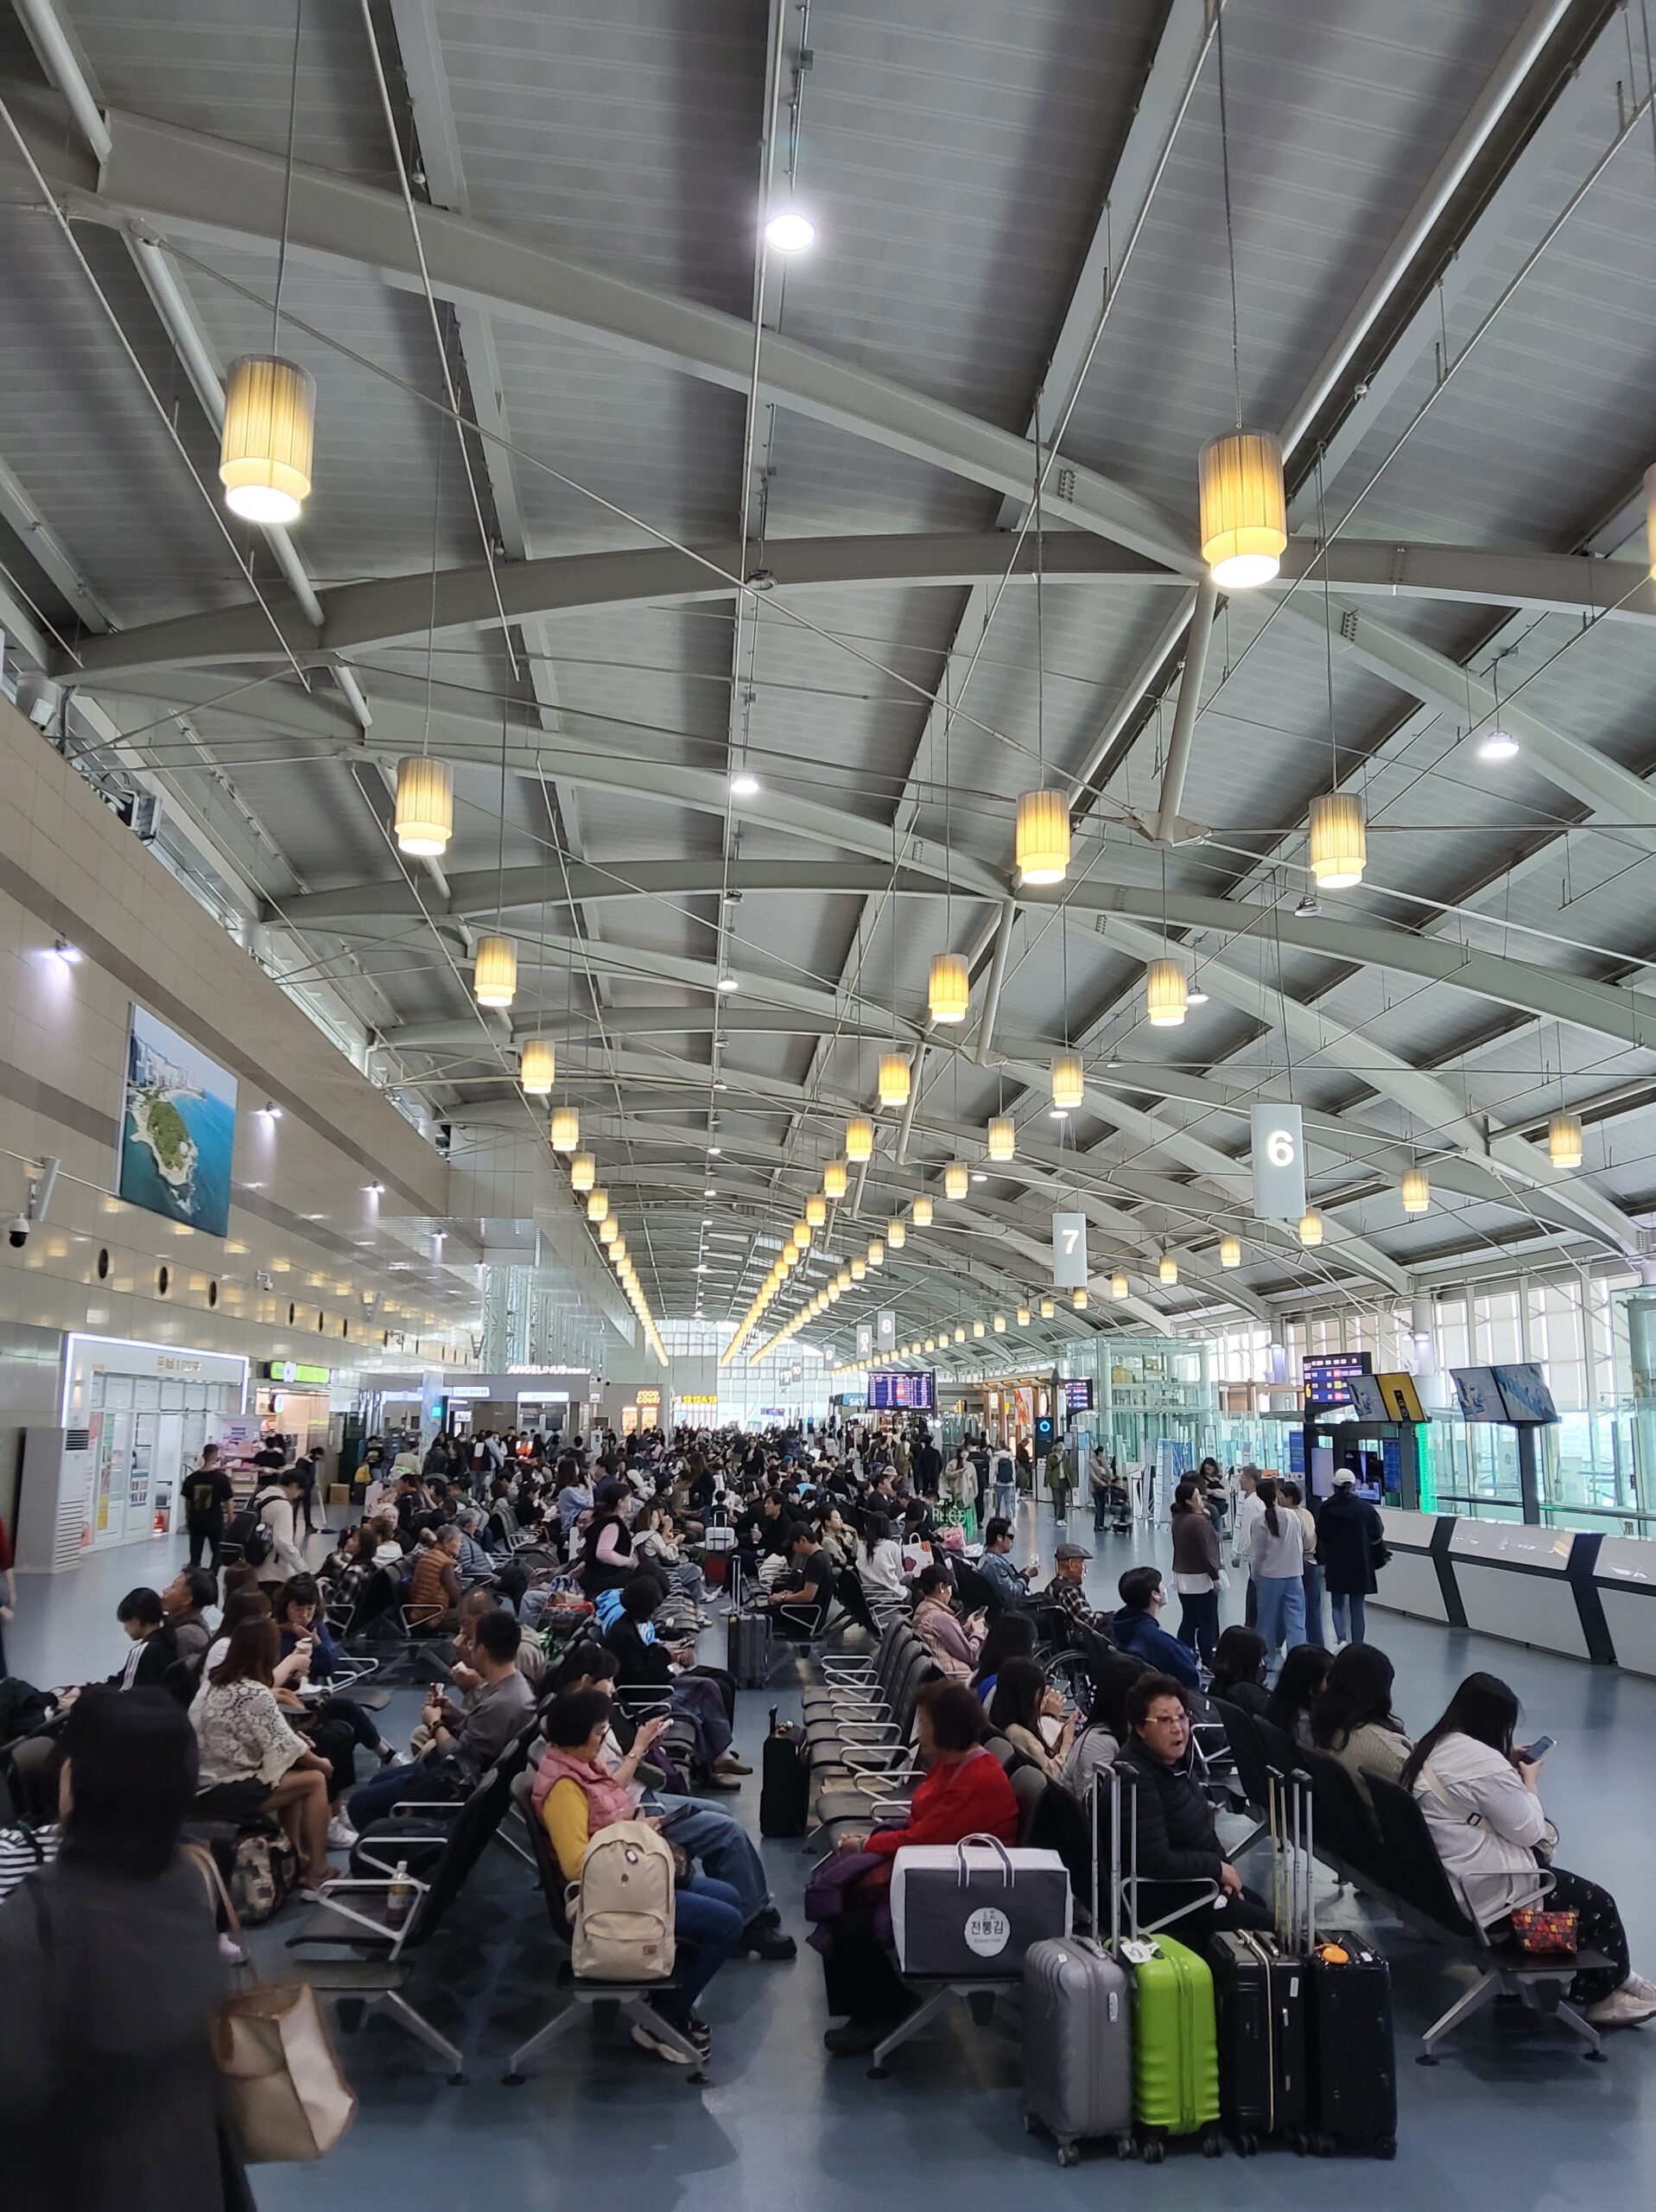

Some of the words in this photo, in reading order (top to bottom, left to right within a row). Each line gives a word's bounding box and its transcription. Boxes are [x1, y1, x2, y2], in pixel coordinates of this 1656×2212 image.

[1267, 1129, 1295, 1167] 6
[1062, 1229, 1080, 1255] 7
[881, 1319, 892, 1334] 8
[860, 1332, 870, 1344] 8
[507, 1364, 568, 1376] ANGELINUS
[1305, 1383, 1311, 1398] 6
[848, 1397, 866, 1407] SKY
[971, 1921, 1004, 1936] 전통김
